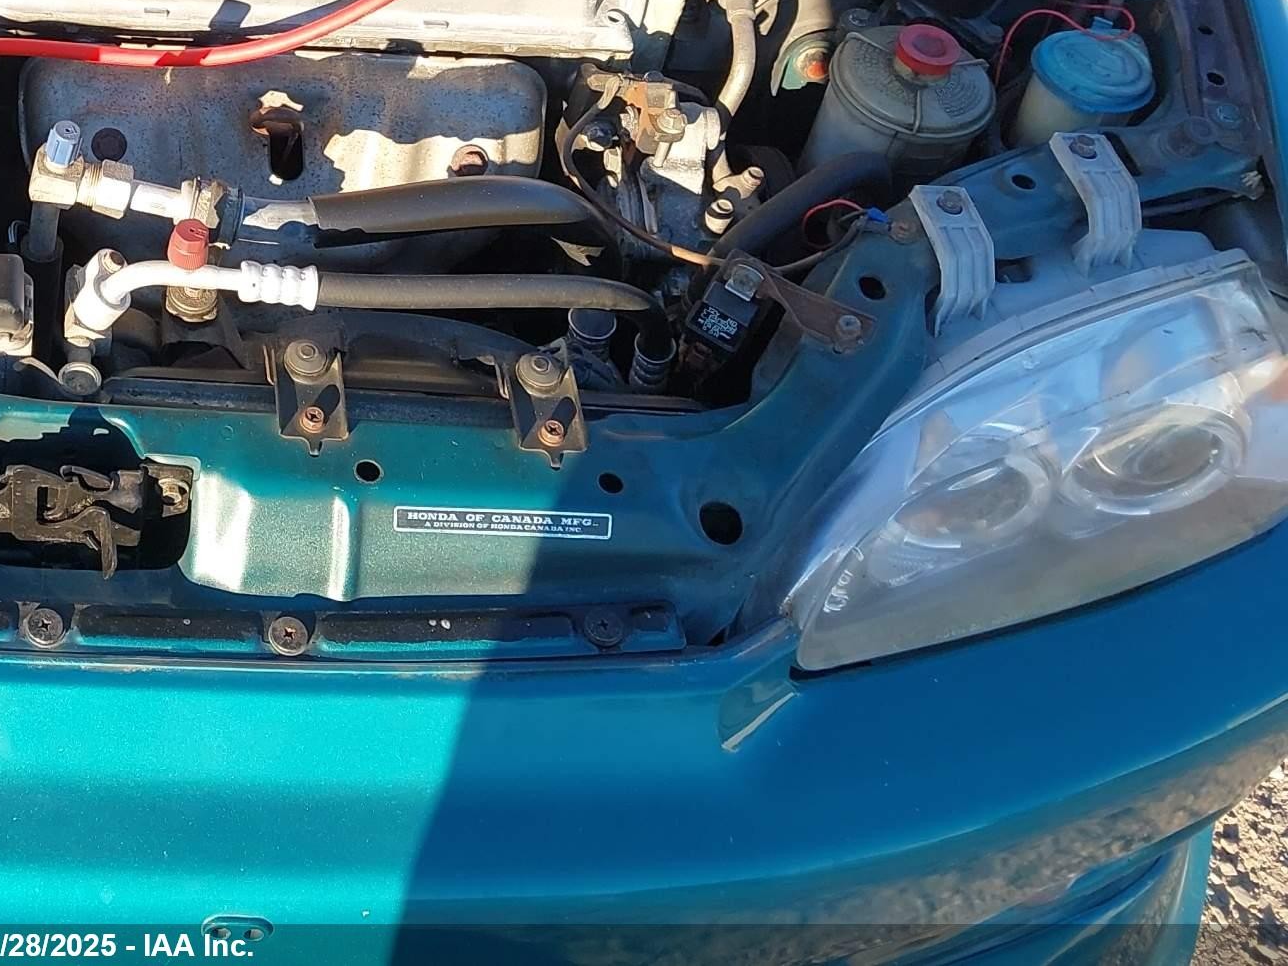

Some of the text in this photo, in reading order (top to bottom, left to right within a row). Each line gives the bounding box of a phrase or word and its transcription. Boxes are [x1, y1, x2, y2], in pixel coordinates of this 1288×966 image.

[407, 512, 459, 522] HONDA
[465, 513, 485, 522] OF
[491, 514, 554, 525] CANADA
[433, 521, 475, 529] DIVISION
[476, 522, 490, 530] OF
[490, 523, 523, 531] HONDA
[524, 524, 564, 532] CANADA
